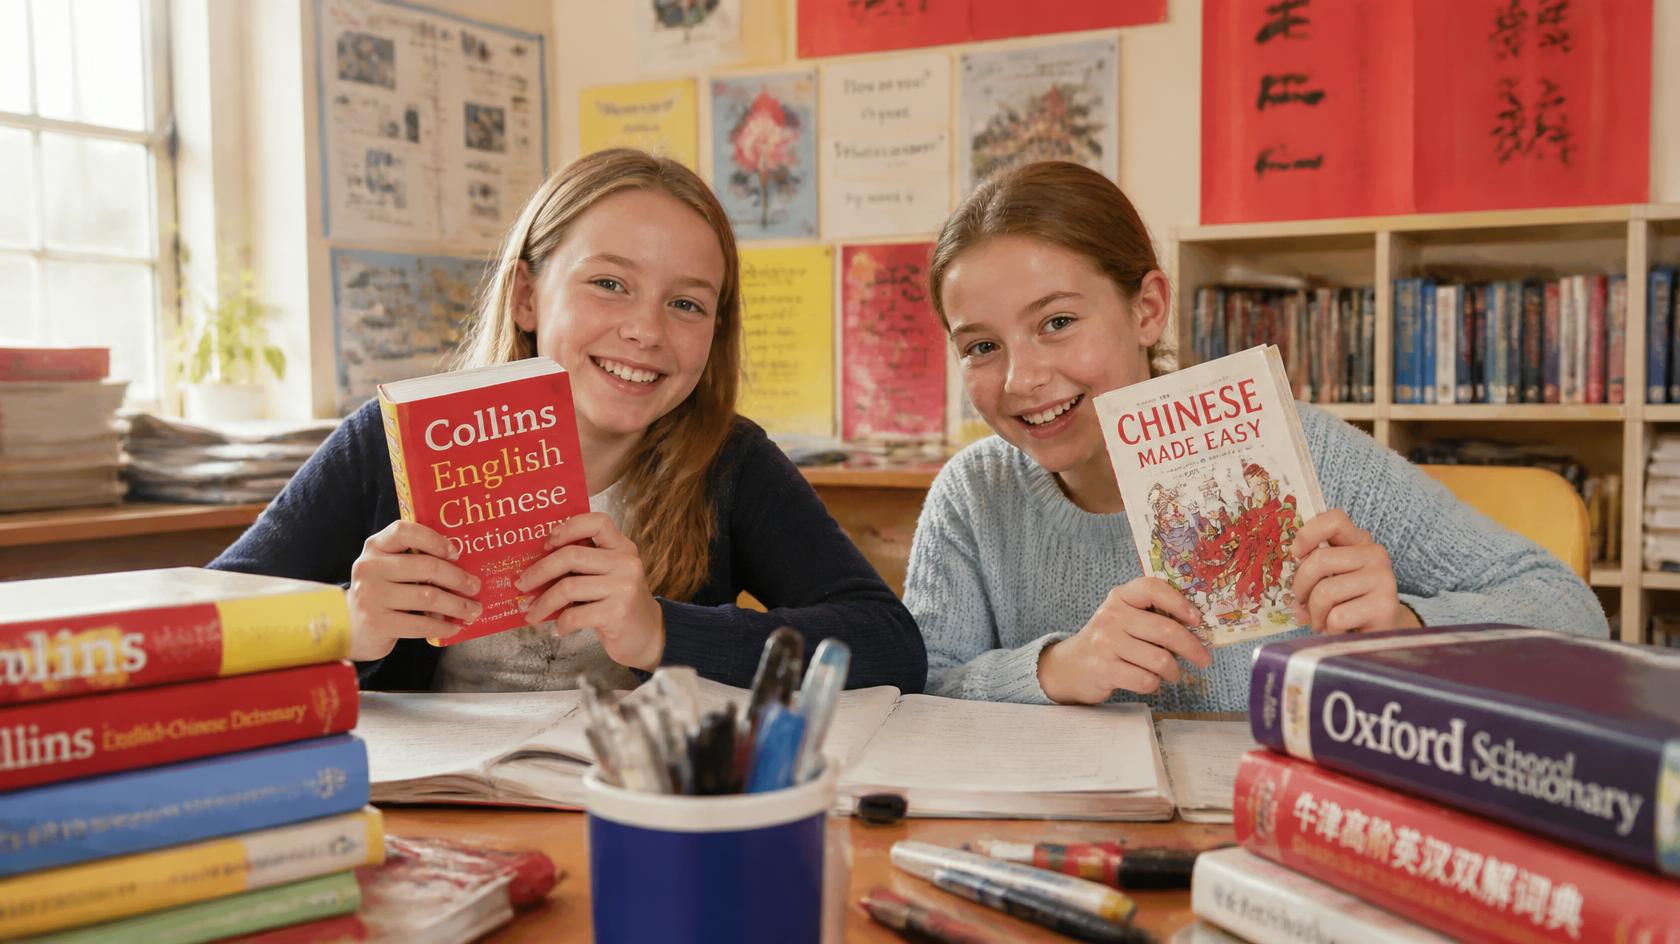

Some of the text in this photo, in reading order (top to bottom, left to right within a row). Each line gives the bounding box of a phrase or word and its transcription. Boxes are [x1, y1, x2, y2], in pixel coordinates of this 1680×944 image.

[425, 404, 557, 451] Collins
[1117, 378, 1263, 445] CHINESE
[430, 438, 565, 492] English
[1137, 436, 1199, 468] MADE
[1204, 419, 1261, 450] EASY
[439, 485, 567, 528] Chinese
[1322, 690, 1467, 775] Oxford
